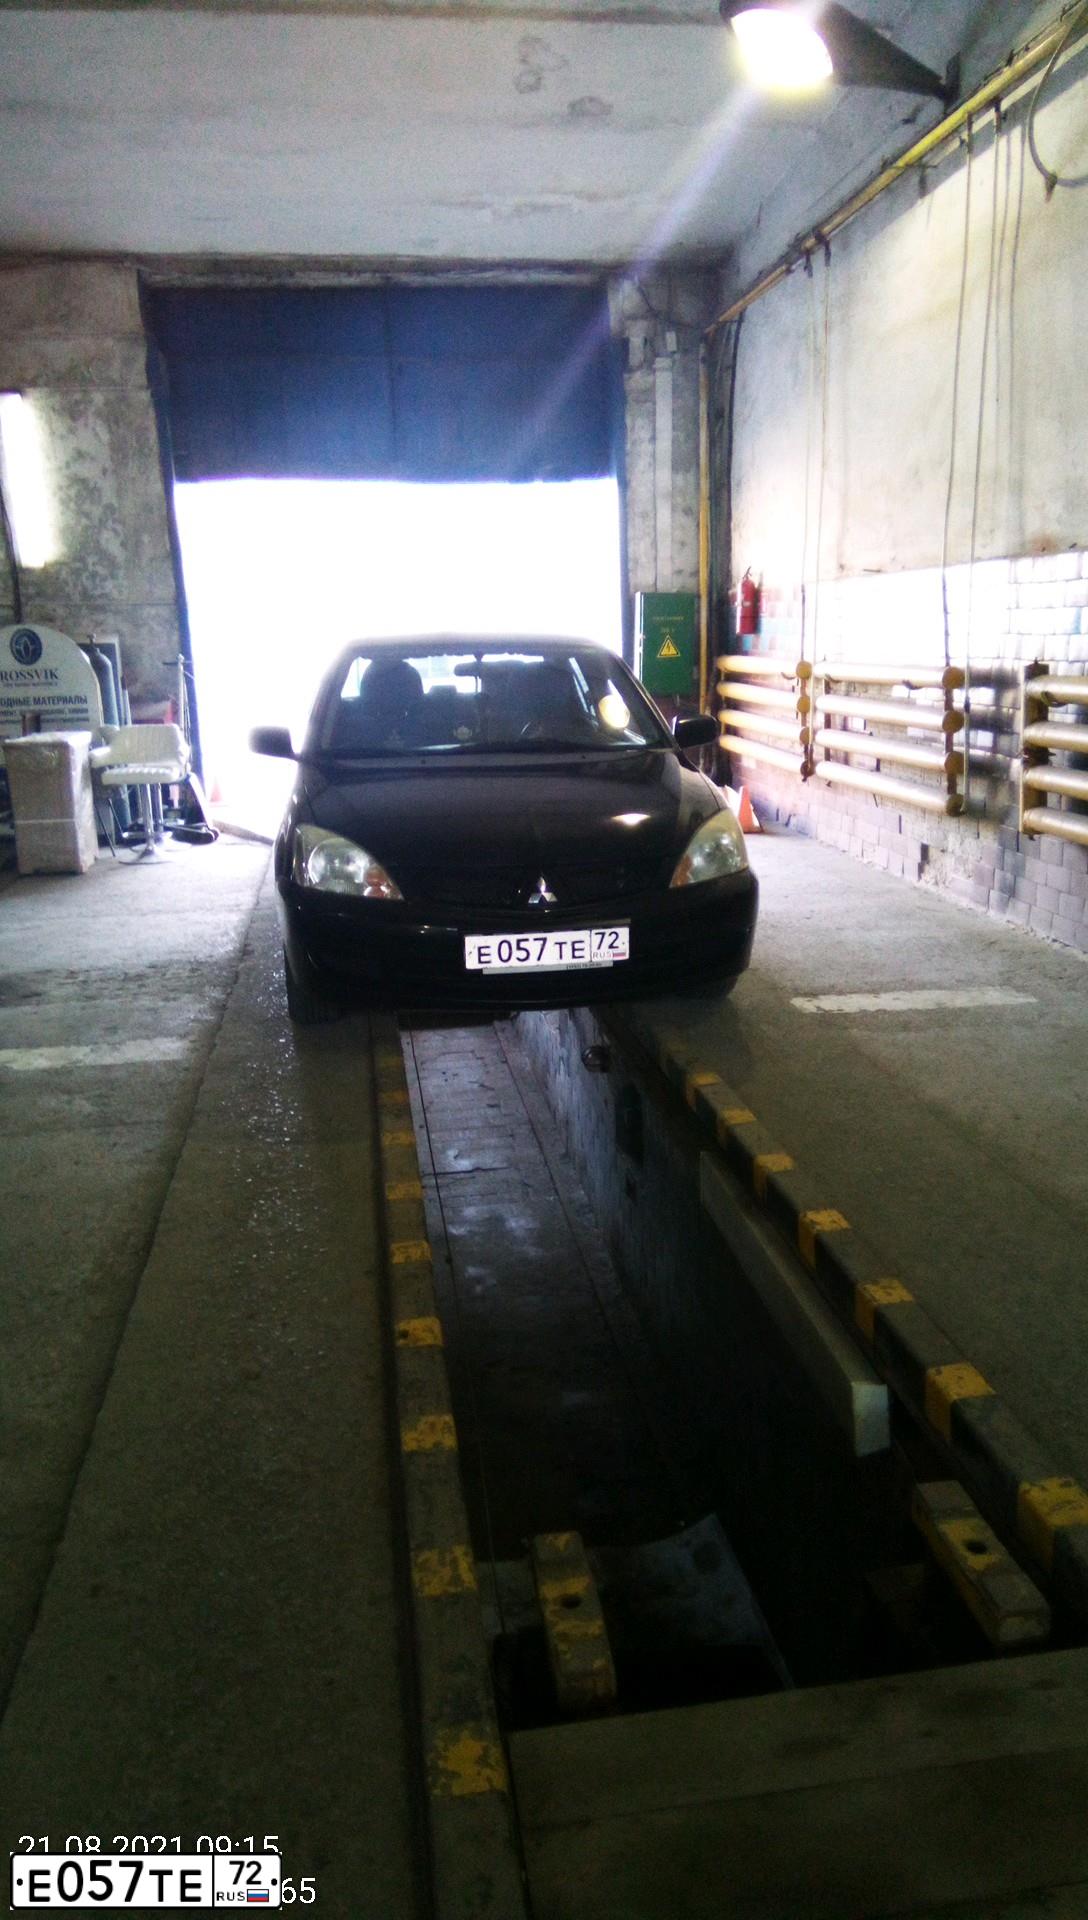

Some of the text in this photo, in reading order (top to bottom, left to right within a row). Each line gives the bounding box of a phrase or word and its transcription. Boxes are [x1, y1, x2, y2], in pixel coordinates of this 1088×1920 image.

[0, 668, 59, 682] ROSSVIK
[33, 695, 88, 705] МАТЕРИАЛЫ
[594, 931, 620, 950] 72
[592, 950, 613, 959] RUS
